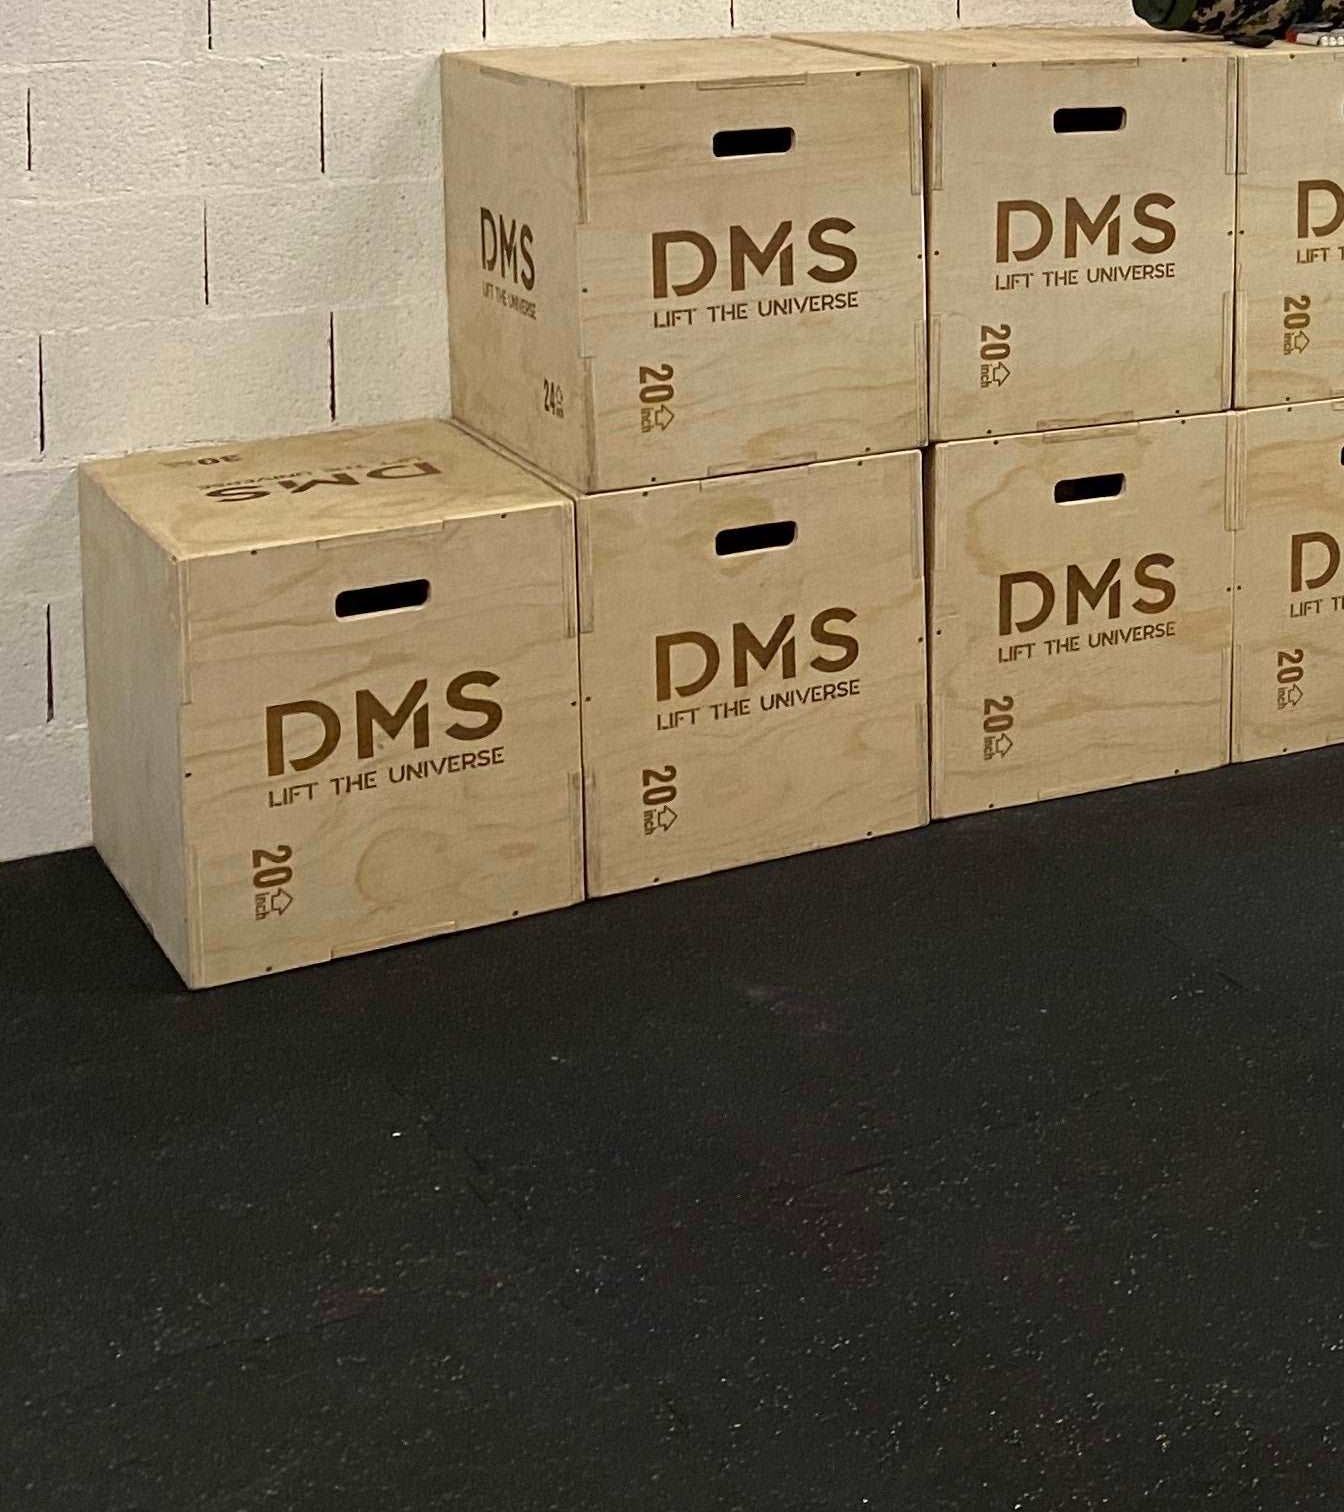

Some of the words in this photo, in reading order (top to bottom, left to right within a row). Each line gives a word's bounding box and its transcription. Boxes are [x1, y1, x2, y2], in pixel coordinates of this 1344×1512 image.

[996, 192, 1176, 263] DMS
[480, 206, 535, 291] DMS
[652, 216, 858, 298] DMS
[1296, 247, 1330, 264] LIFT
[995, 272, 1034, 291] LIFT
[1042, 269, 1079, 287] THE
[1087, 263, 1175, 284] UNIVERSE
[653, 308, 697, 328] LIFT
[706, 303, 748, 322] THE
[758, 291, 859, 317] UNIVERSE
[1283, 295, 1311, 329] 20
[980, 324, 1011, 361] 20
[543, 377, 555, 416] 24
[639, 363, 674, 404] 20
[206, 462, 442, 502] DMS
[999, 553, 1176, 636] DMS
[1290, 599, 1323, 618] LIFT
[655, 607, 859, 701] DMS
[998, 643, 1036, 664] LIFT
[1043, 636, 1080, 655] THE
[1088, 621, 1176, 648] UNIVERSE
[1277, 648, 1303, 684] 20
[266, 670, 503, 777] DMS
[657, 707, 701, 730] LIFT
[710, 699, 751, 720] THE
[760, 679, 860, 711] UNIVERSE
[984, 696, 1014, 732] 20
[268, 782, 318, 808] LIFT
[329, 771, 377, 795] THE
[388, 746, 504, 783] UNIVERSE
[642, 765, 677, 806] 20
[252, 845, 293, 887] 20
